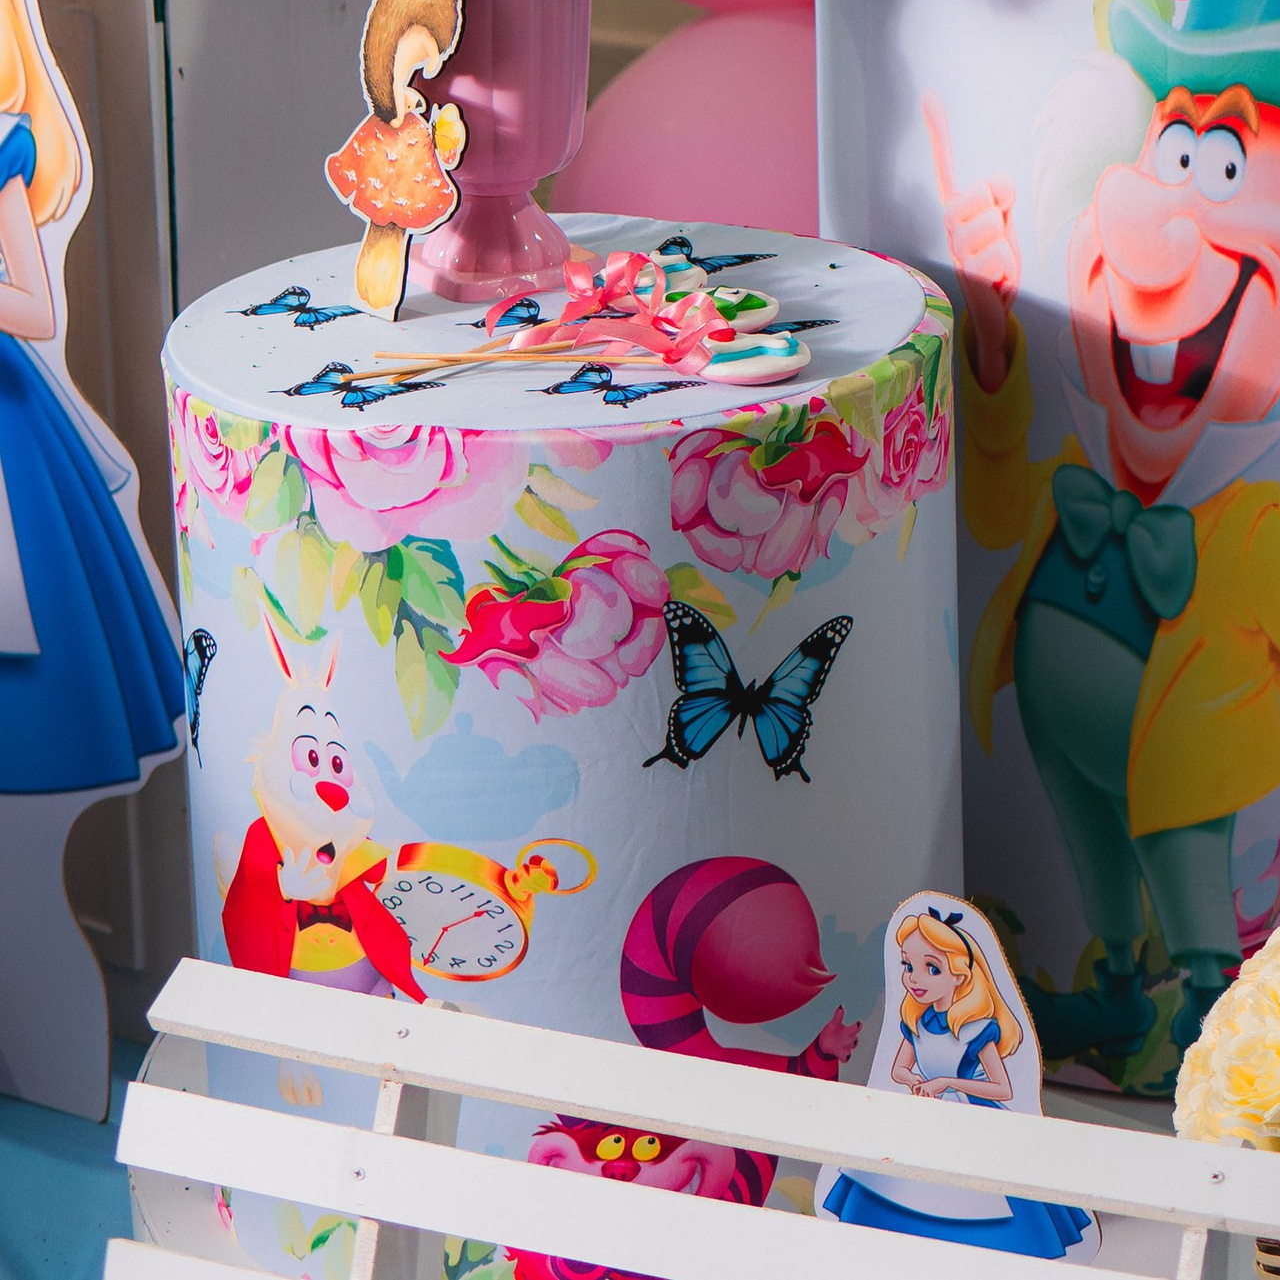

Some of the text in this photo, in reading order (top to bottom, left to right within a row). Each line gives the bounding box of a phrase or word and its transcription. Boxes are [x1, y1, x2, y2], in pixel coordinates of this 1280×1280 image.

[394, 880, 413, 893] 9
[418, 876, 443, 894] 10
[450, 884, 475, 901] 11
[382, 895, 403, 910] 8
[477, 899, 505, 919] 12
[497, 923, 513, 933] 1
[494, 940, 515, 954] 2
[449, 956, 467, 969] 4
[477, 954, 498, 968] 3
